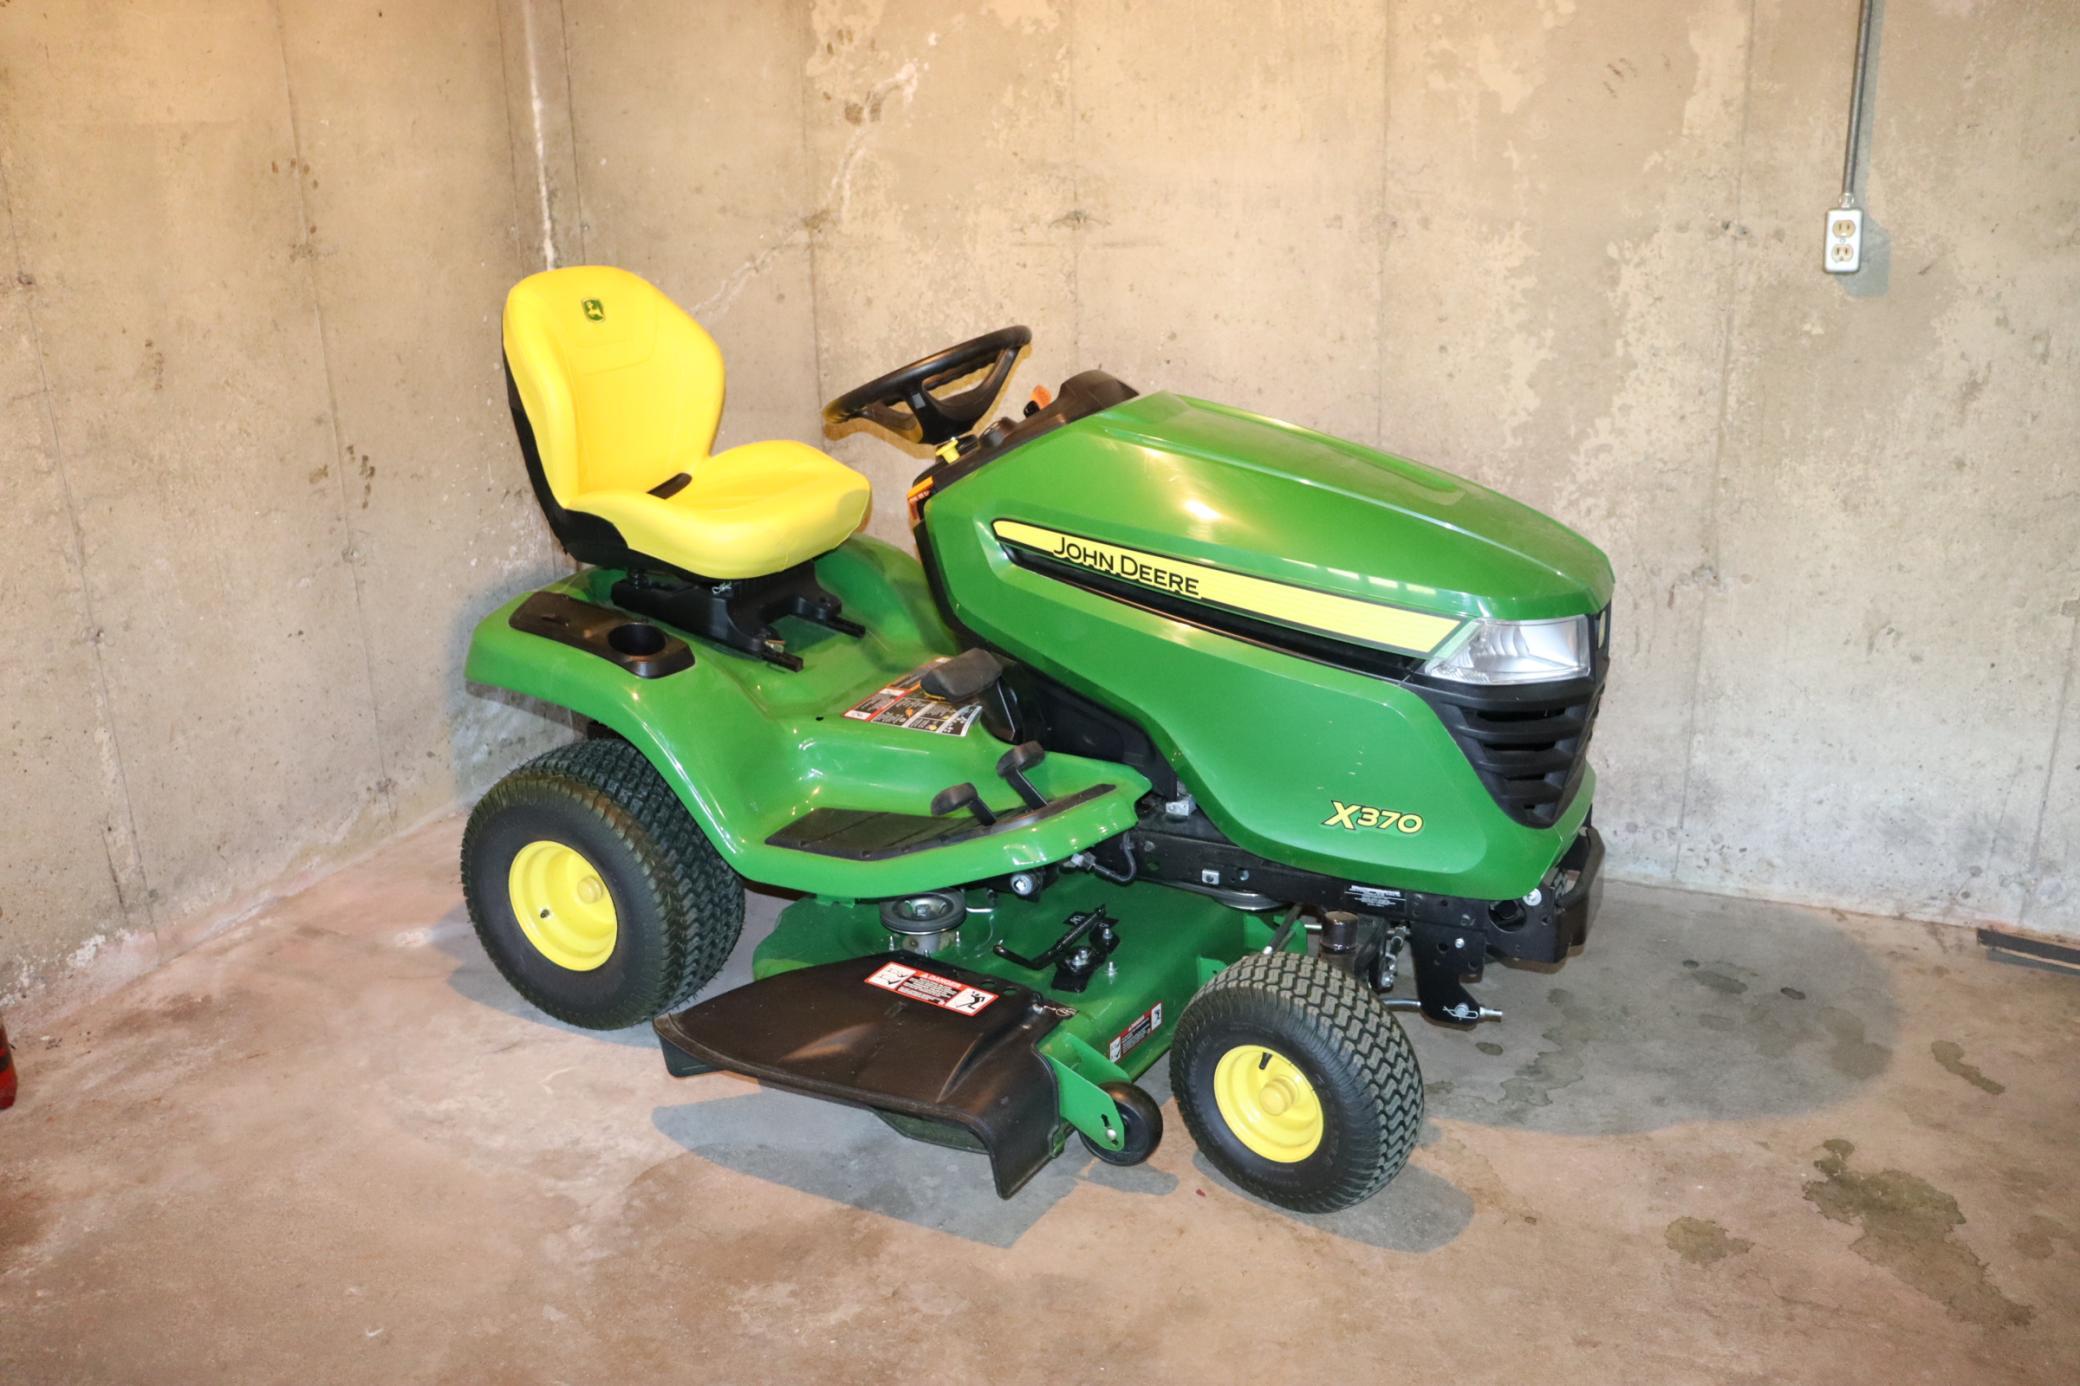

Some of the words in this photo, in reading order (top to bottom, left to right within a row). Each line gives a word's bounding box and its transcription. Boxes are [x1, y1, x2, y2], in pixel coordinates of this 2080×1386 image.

[1054, 537, 1114, 571] JOHN
[1120, 554, 1200, 595] DEERE
[1321, 800, 1423, 834] X370
